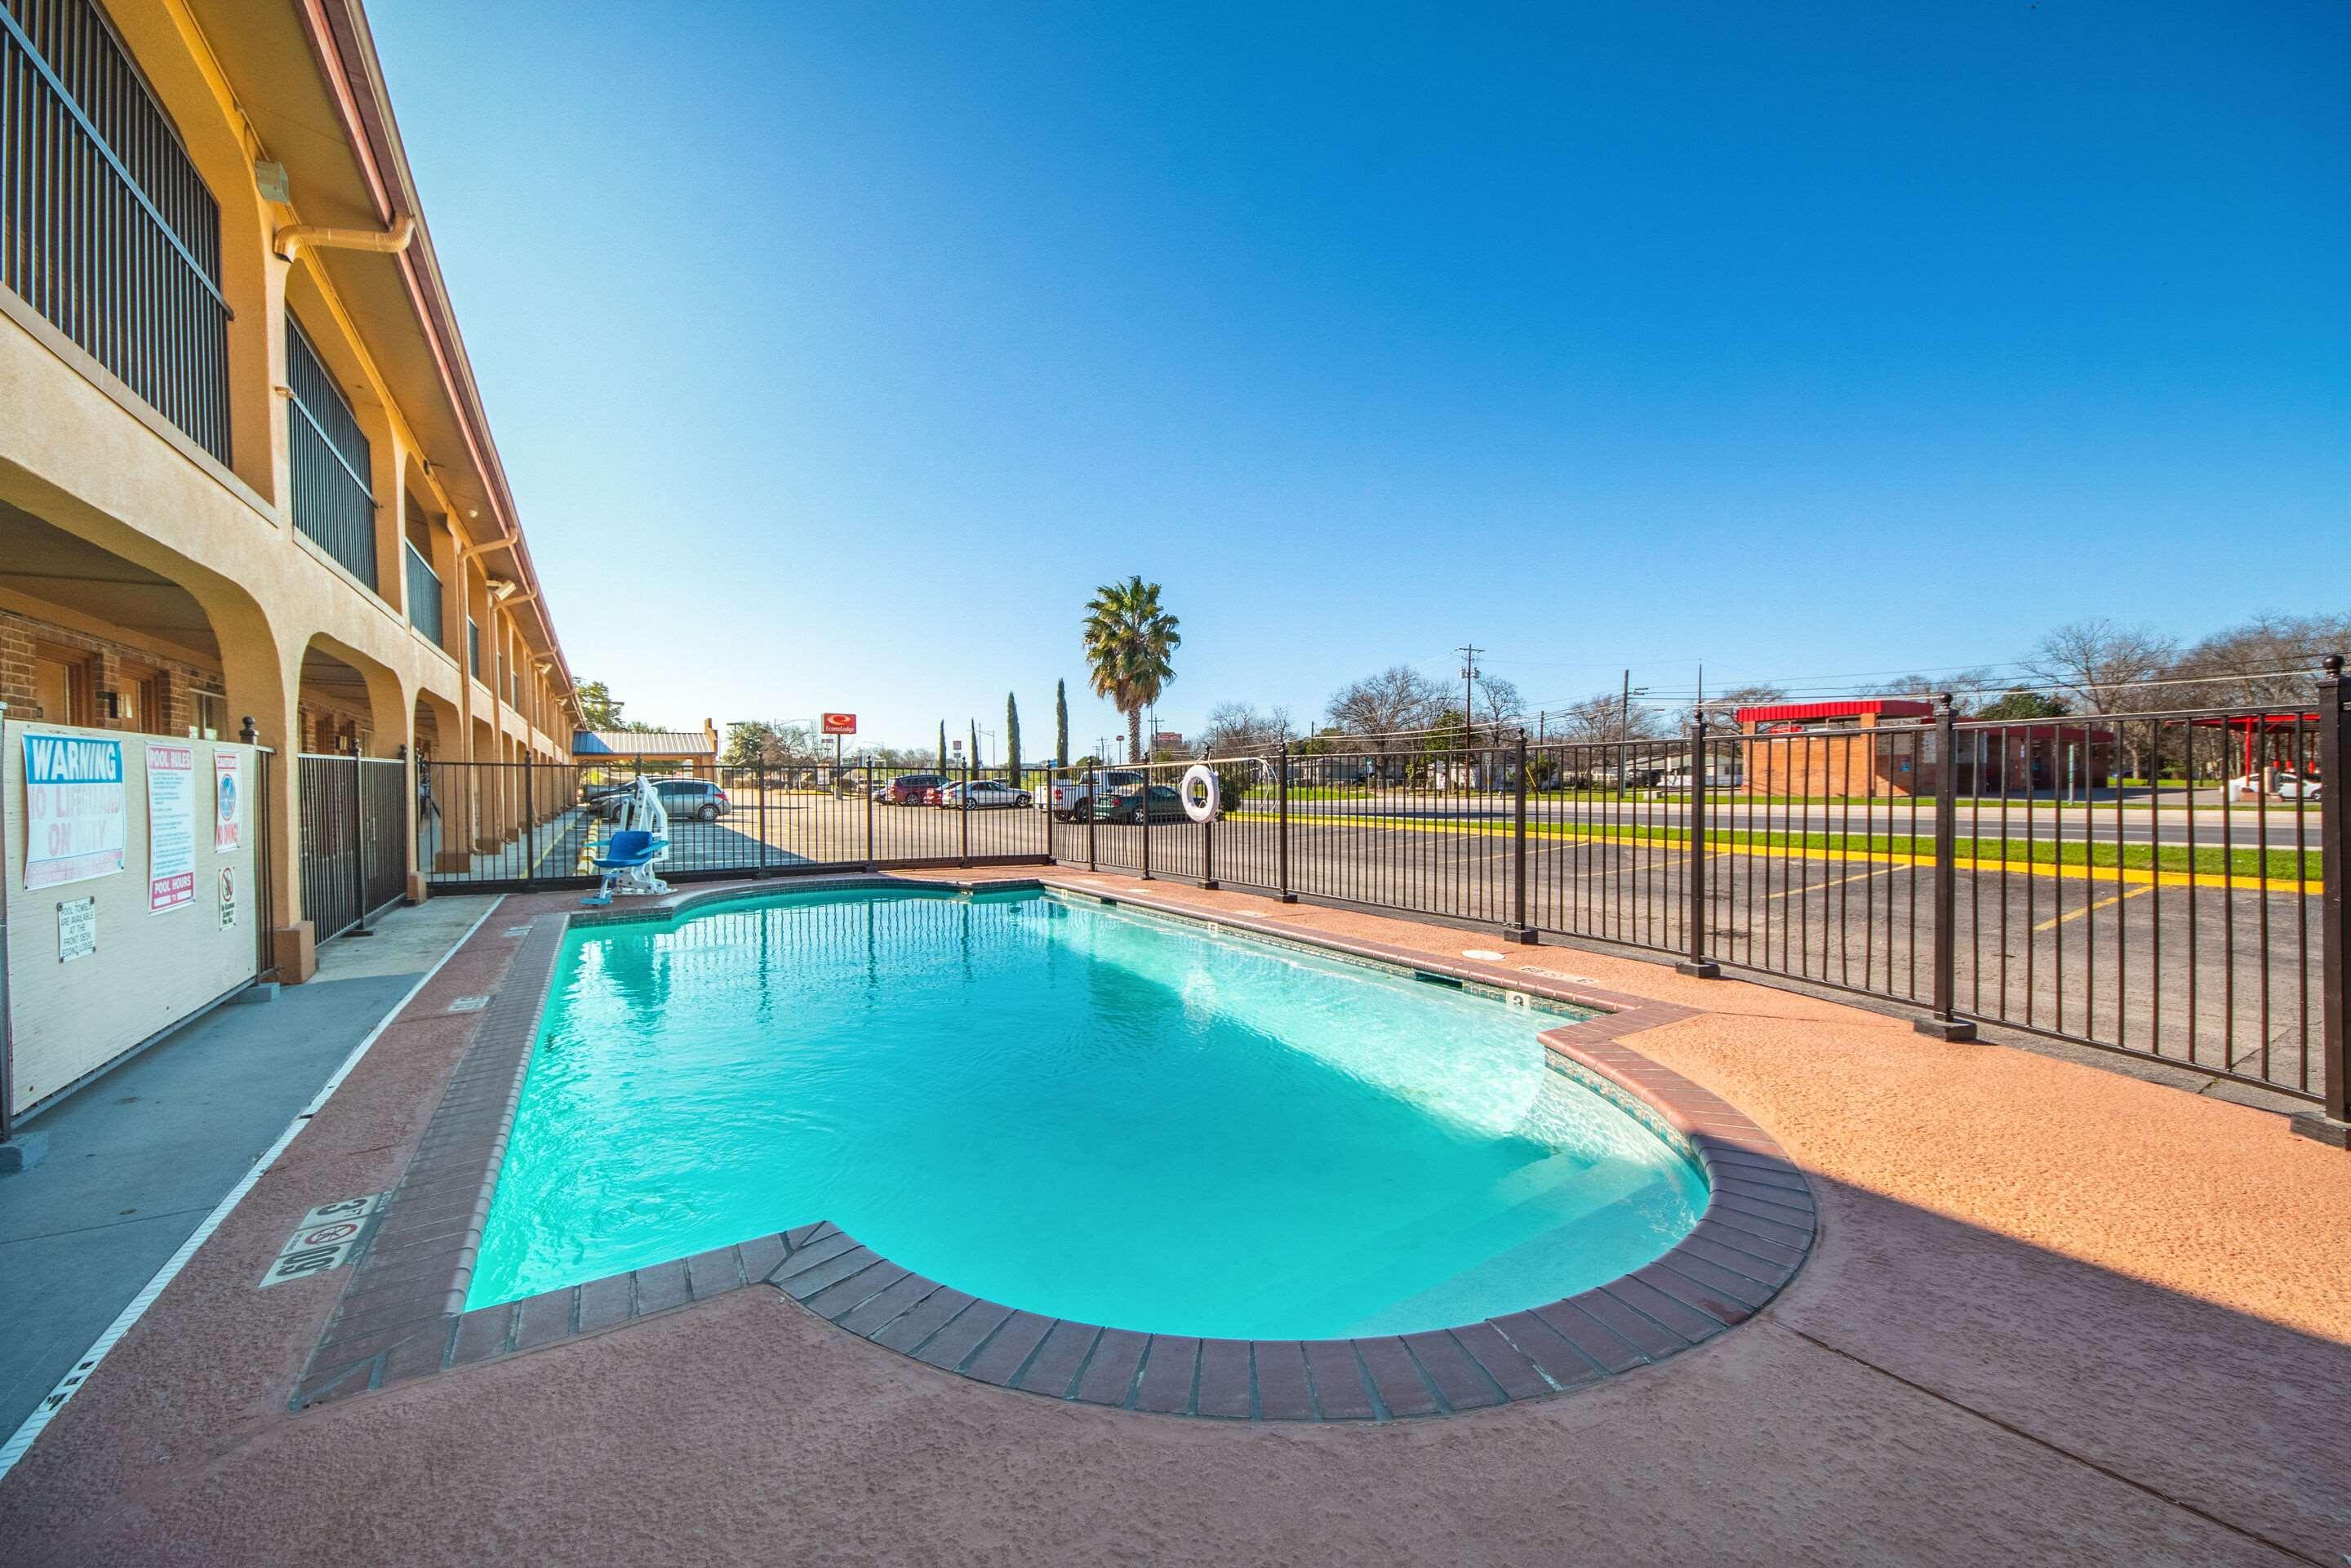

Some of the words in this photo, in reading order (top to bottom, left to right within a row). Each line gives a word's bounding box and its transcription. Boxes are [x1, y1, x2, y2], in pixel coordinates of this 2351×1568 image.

[32, 739, 117, 780] WARNING
[149, 749, 170, 767] POOL
[171, 750, 190, 768] RULES
[47, 822, 71, 855] ON
[154, 880, 171, 895] POOL
[171, 874, 191, 890] HOURS
[316, 1198, 367, 1215] 3
